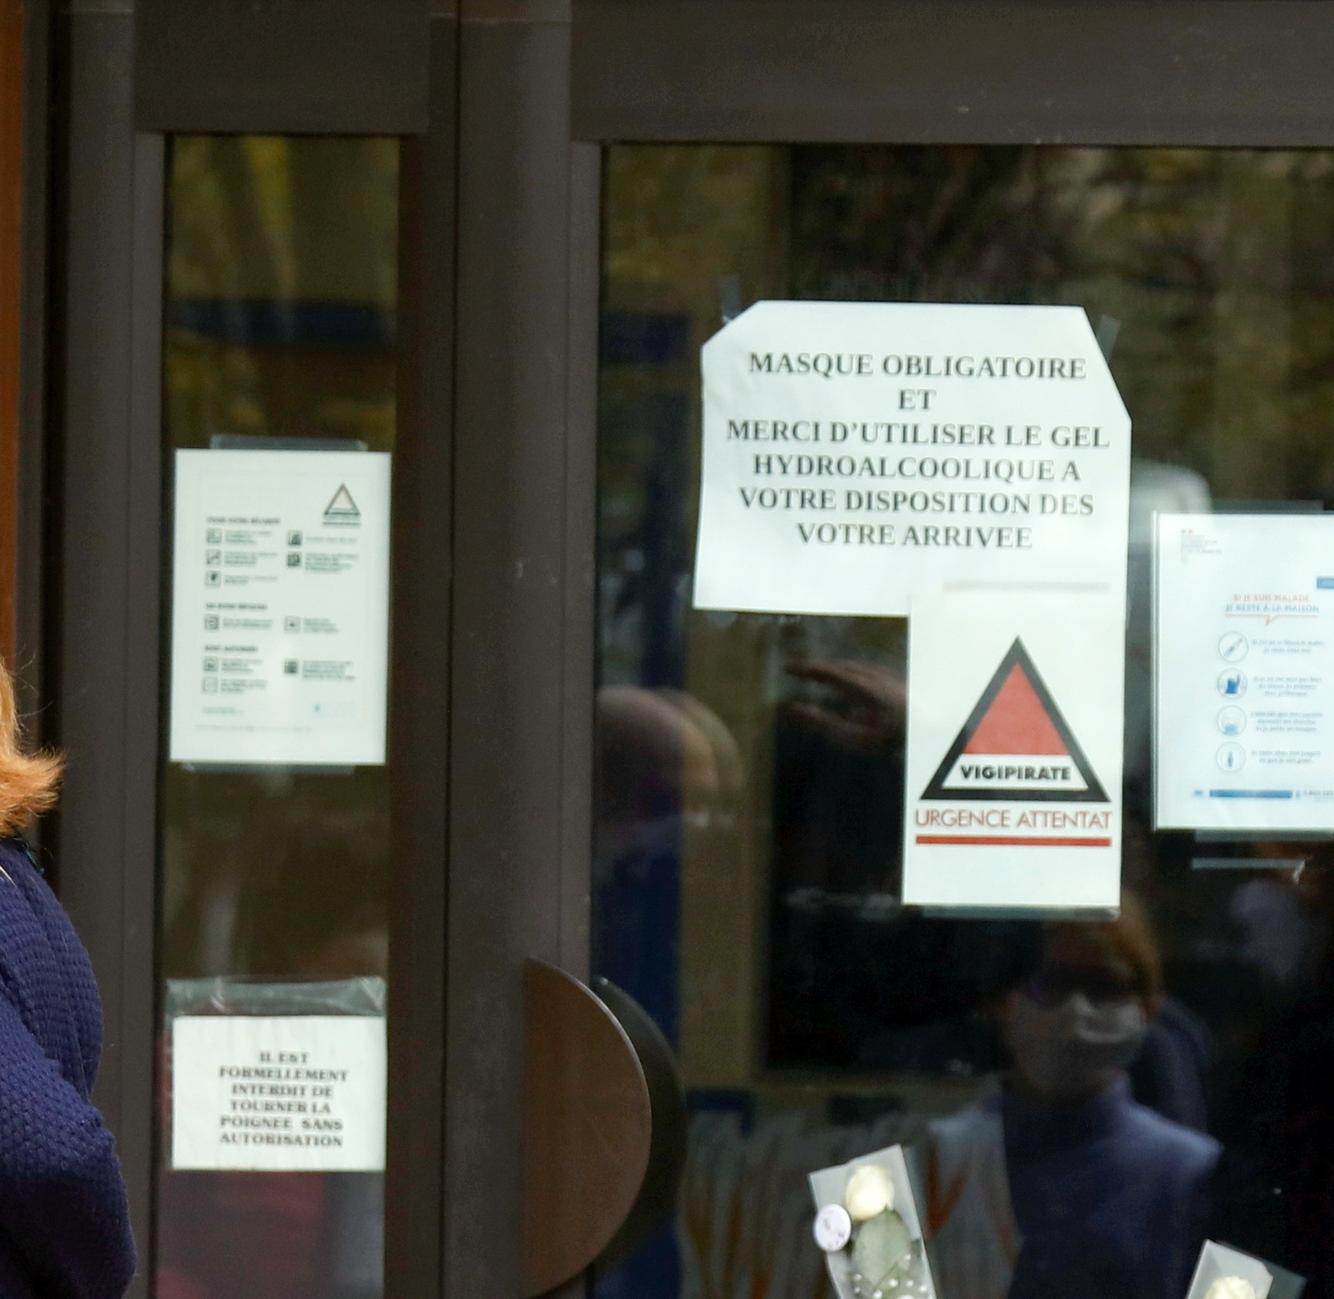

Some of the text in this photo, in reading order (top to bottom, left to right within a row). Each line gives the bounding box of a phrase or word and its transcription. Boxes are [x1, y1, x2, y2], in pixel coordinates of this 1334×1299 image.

[749, 352, 1086, 378] MASQUE OBLIGATOIRE
[898, 389, 937, 410] ET
[727, 420, 1110, 448] MERCI D'UTILISER LE GEL
[753, 455, 1080, 482] HYDROALCOOLIQUE A
[740, 488, 1093, 515] VOTRE DISPOSITION DES
[797, 523, 1033, 549] VOTRE ARRIVEE
[960, 765, 1072, 782] VIGIPIRATE
[915, 809, 1113, 830] URGENCE ATTENTAT
[260, 1052, 309, 1062] IL EST
[219, 1066, 349, 1081] FORMELLEMENT
[232, 1083, 333, 1096] INTERDIT DE
[231, 1100, 331, 1113] TOURNER LA
[220, 1116, 343, 1130] POIGNEE SANS
[220, 1132, 343, 1146] AUTORISATION
